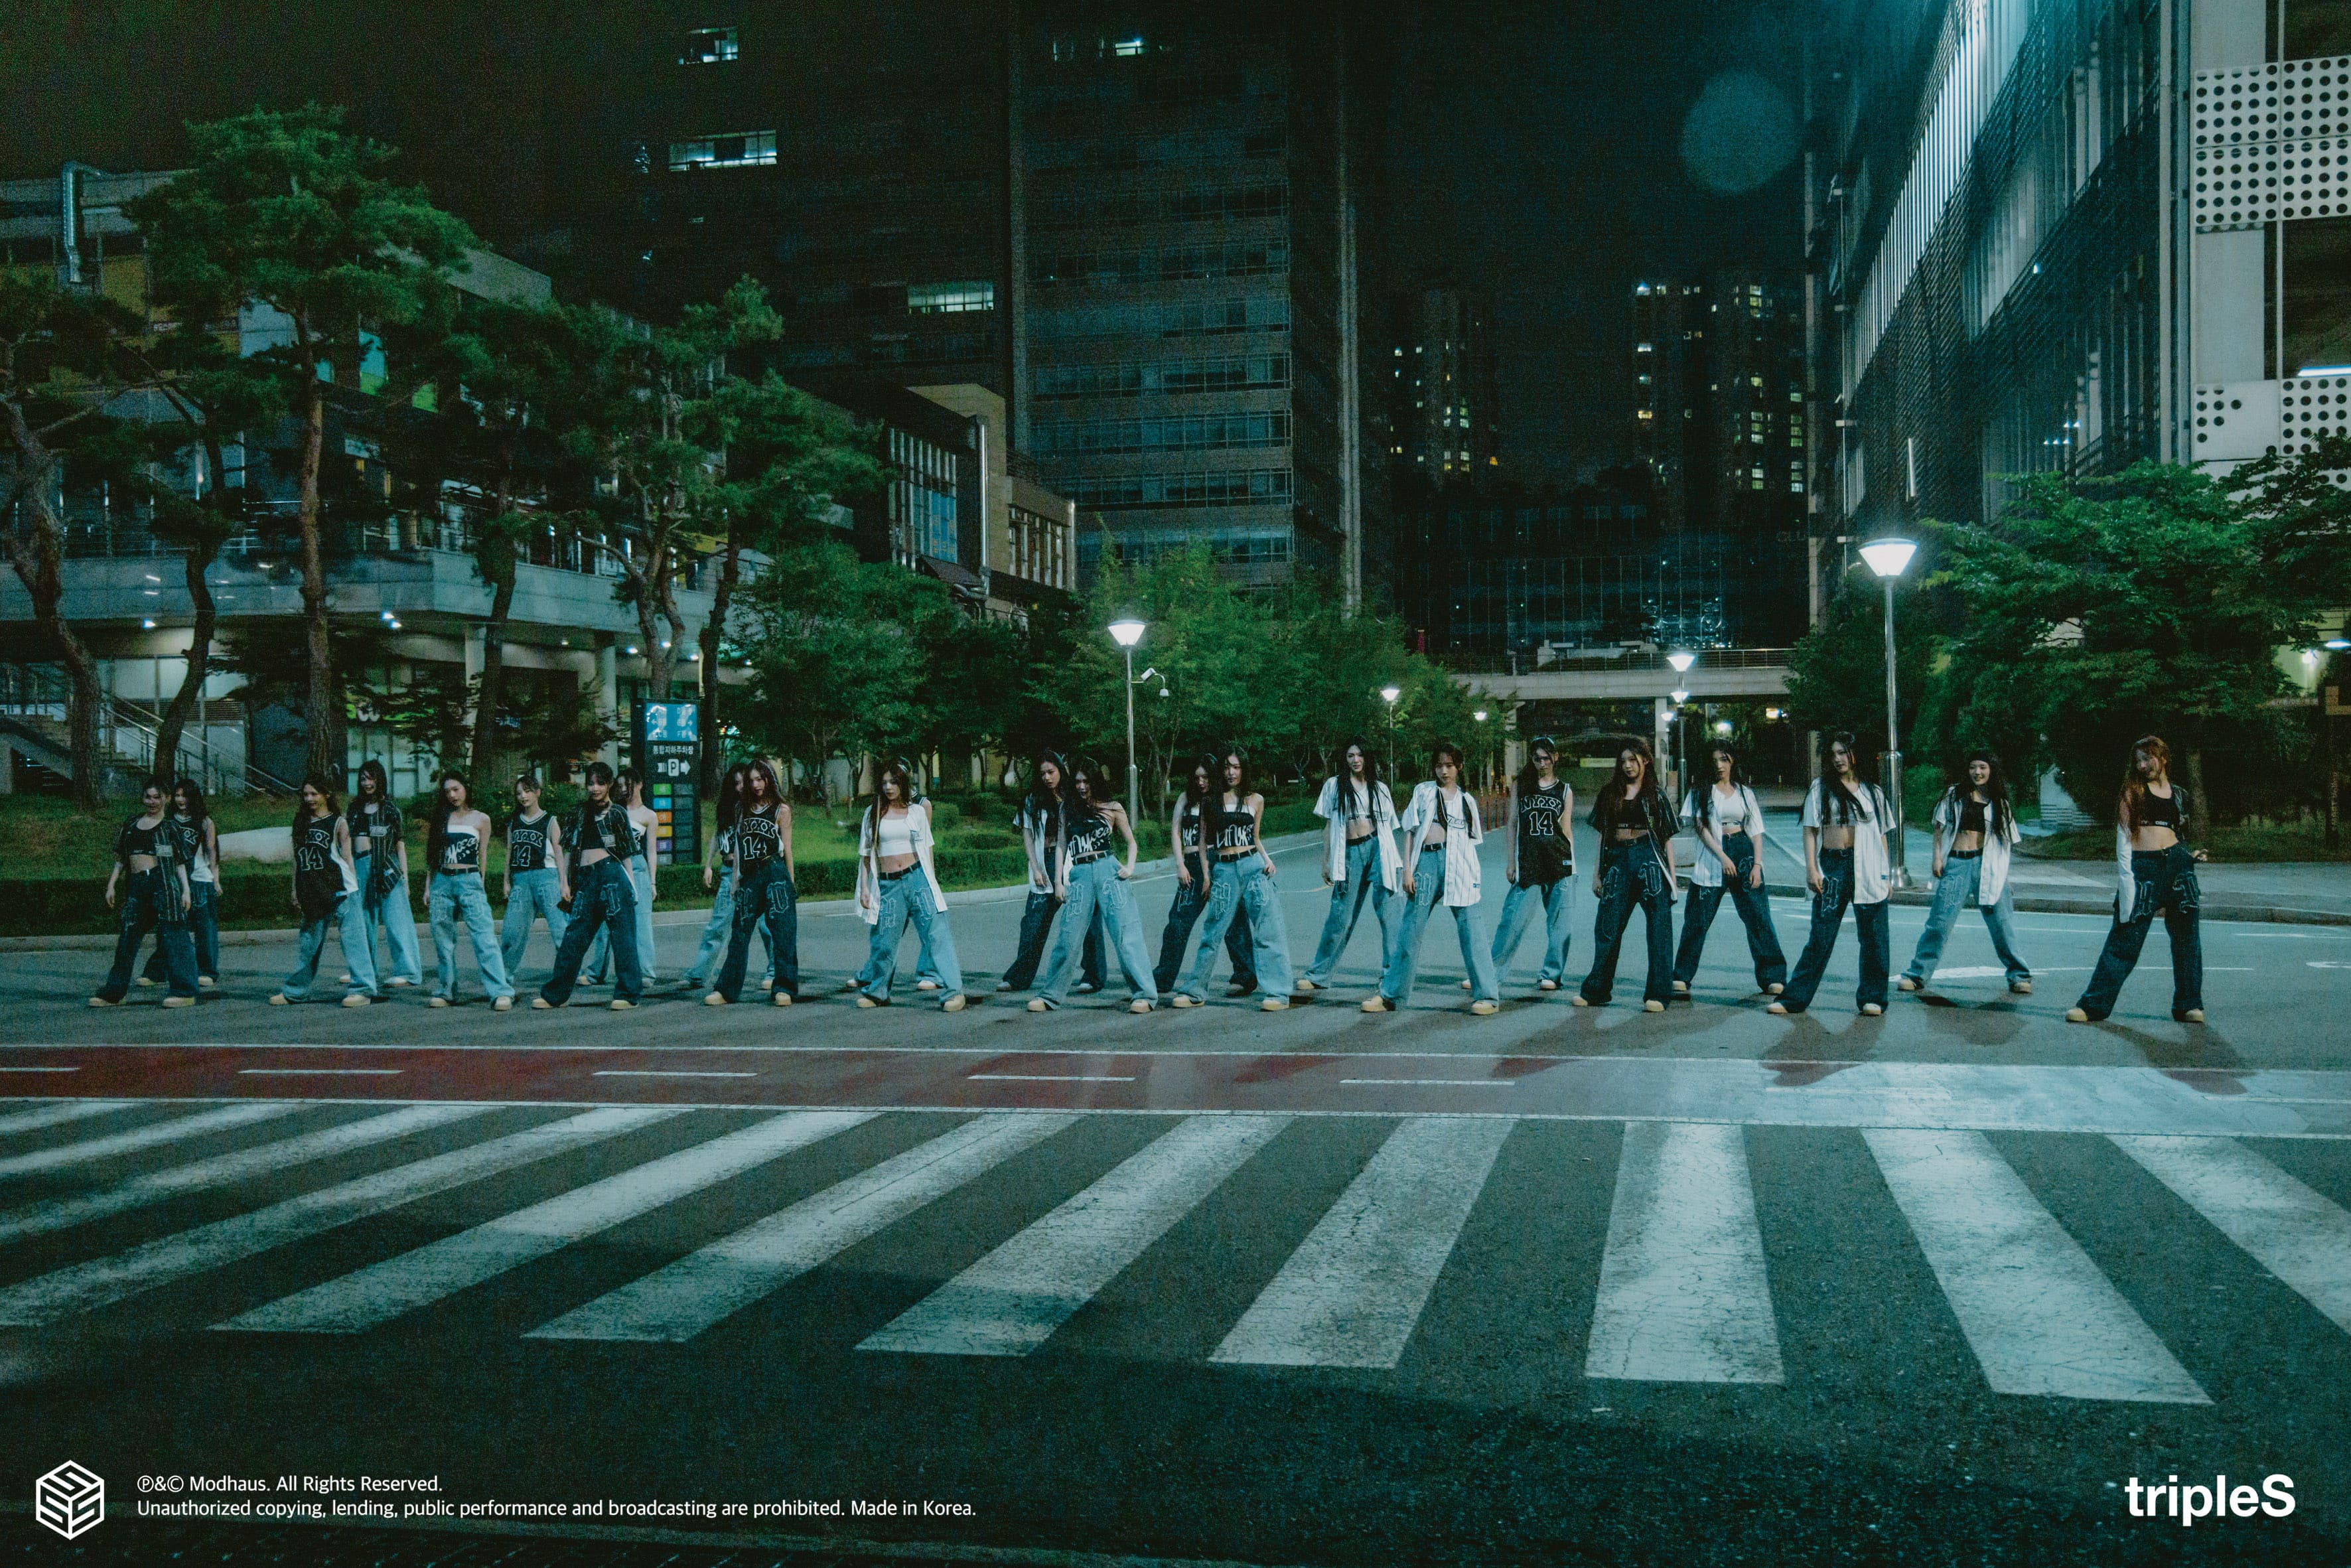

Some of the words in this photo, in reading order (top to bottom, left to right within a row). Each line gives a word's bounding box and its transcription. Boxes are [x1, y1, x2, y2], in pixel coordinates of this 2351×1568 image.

[652, 745, 694, 755] 통합지하주차장
[1528, 811, 1554, 836] 14
[297, 846, 324, 871] 14
[510, 845, 532, 867] 14
[742, 836, 768, 861] 14
